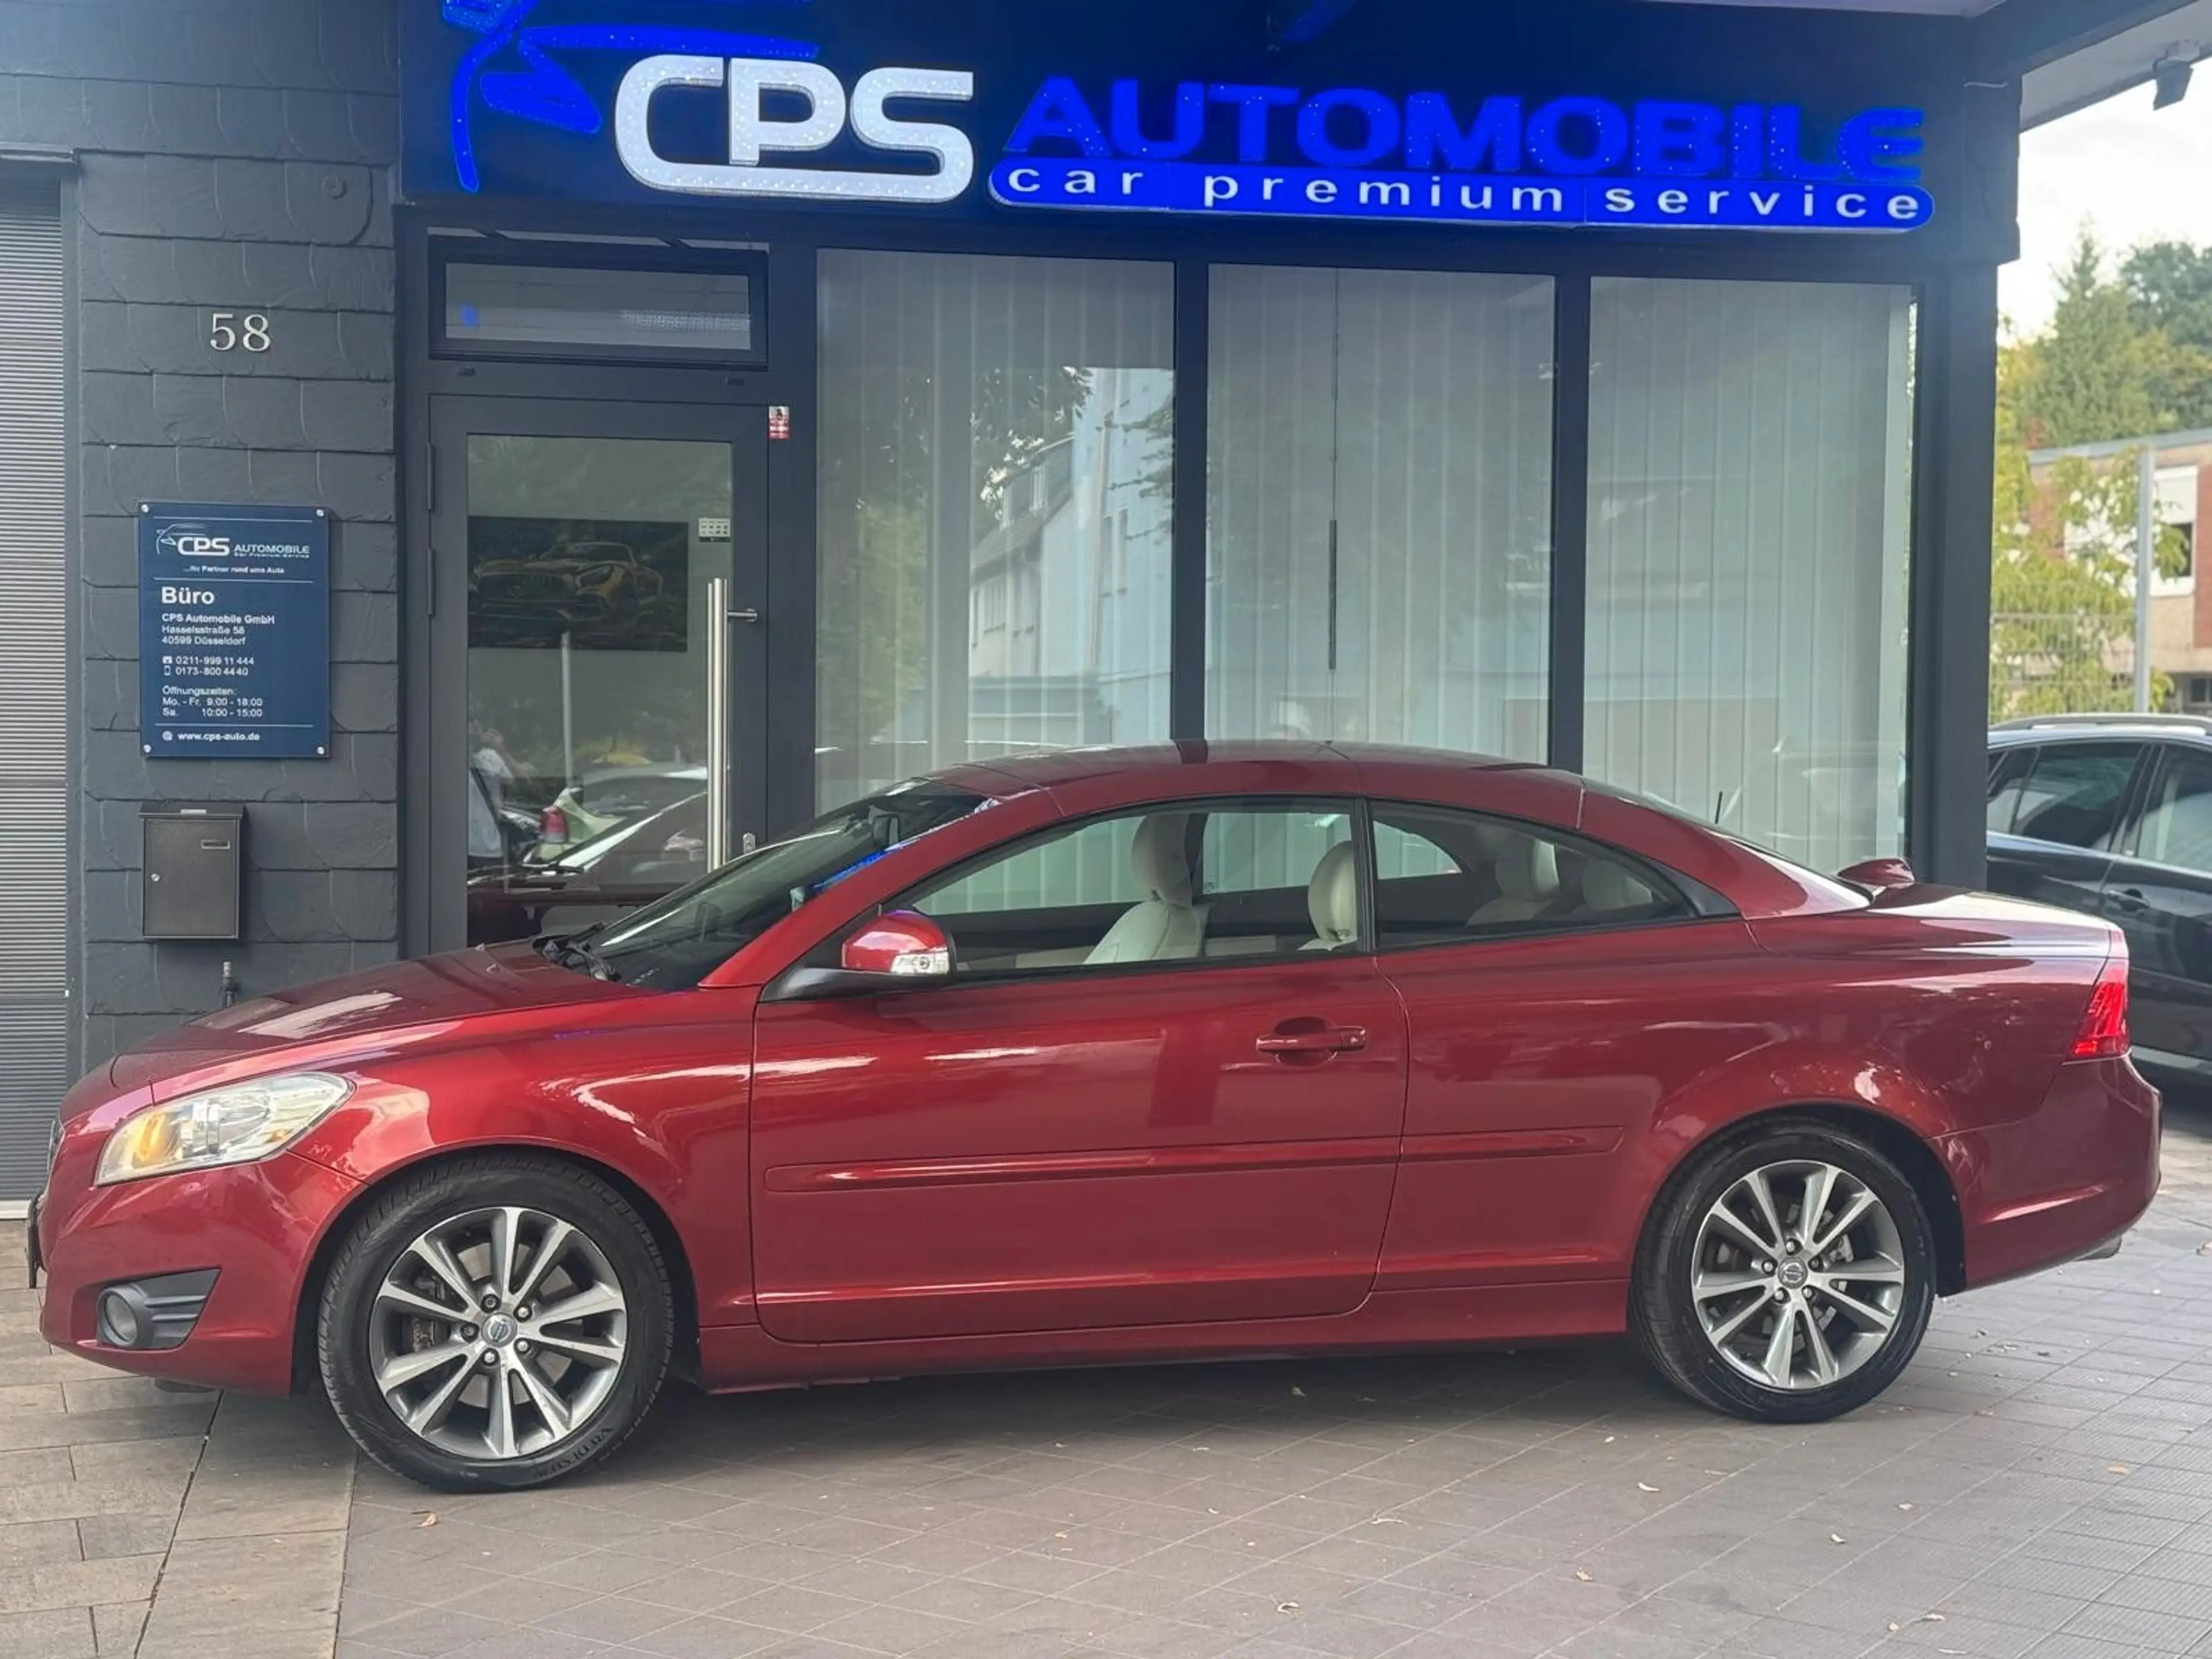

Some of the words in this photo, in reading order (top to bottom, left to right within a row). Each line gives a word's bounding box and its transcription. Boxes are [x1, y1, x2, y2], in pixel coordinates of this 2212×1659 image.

[614, 54, 974, 203] CPS
[1002, 74, 1925, 183] AUTOMOBILE
[1008, 168, 1144, 195] car
[1204, 175, 1562, 212] premium
[1605, 184, 1919, 219] service
[210, 313, 270, 351] 58
[177, 536, 230, 556] CPS
[233, 543, 310, 554] AUTOMOBILE
[161, 586, 215, 605] Büro
[161, 613, 183, 622] CPS
[185, 613, 241, 624] Automobile
[244, 615, 275, 624] GmbH
[232, 626, 245, 634] 58
[194, 635, 246, 645] Düsseldorf
[202, 708, 228, 717] 10:00
[177, 732, 260, 742] www.cps-auto.de
